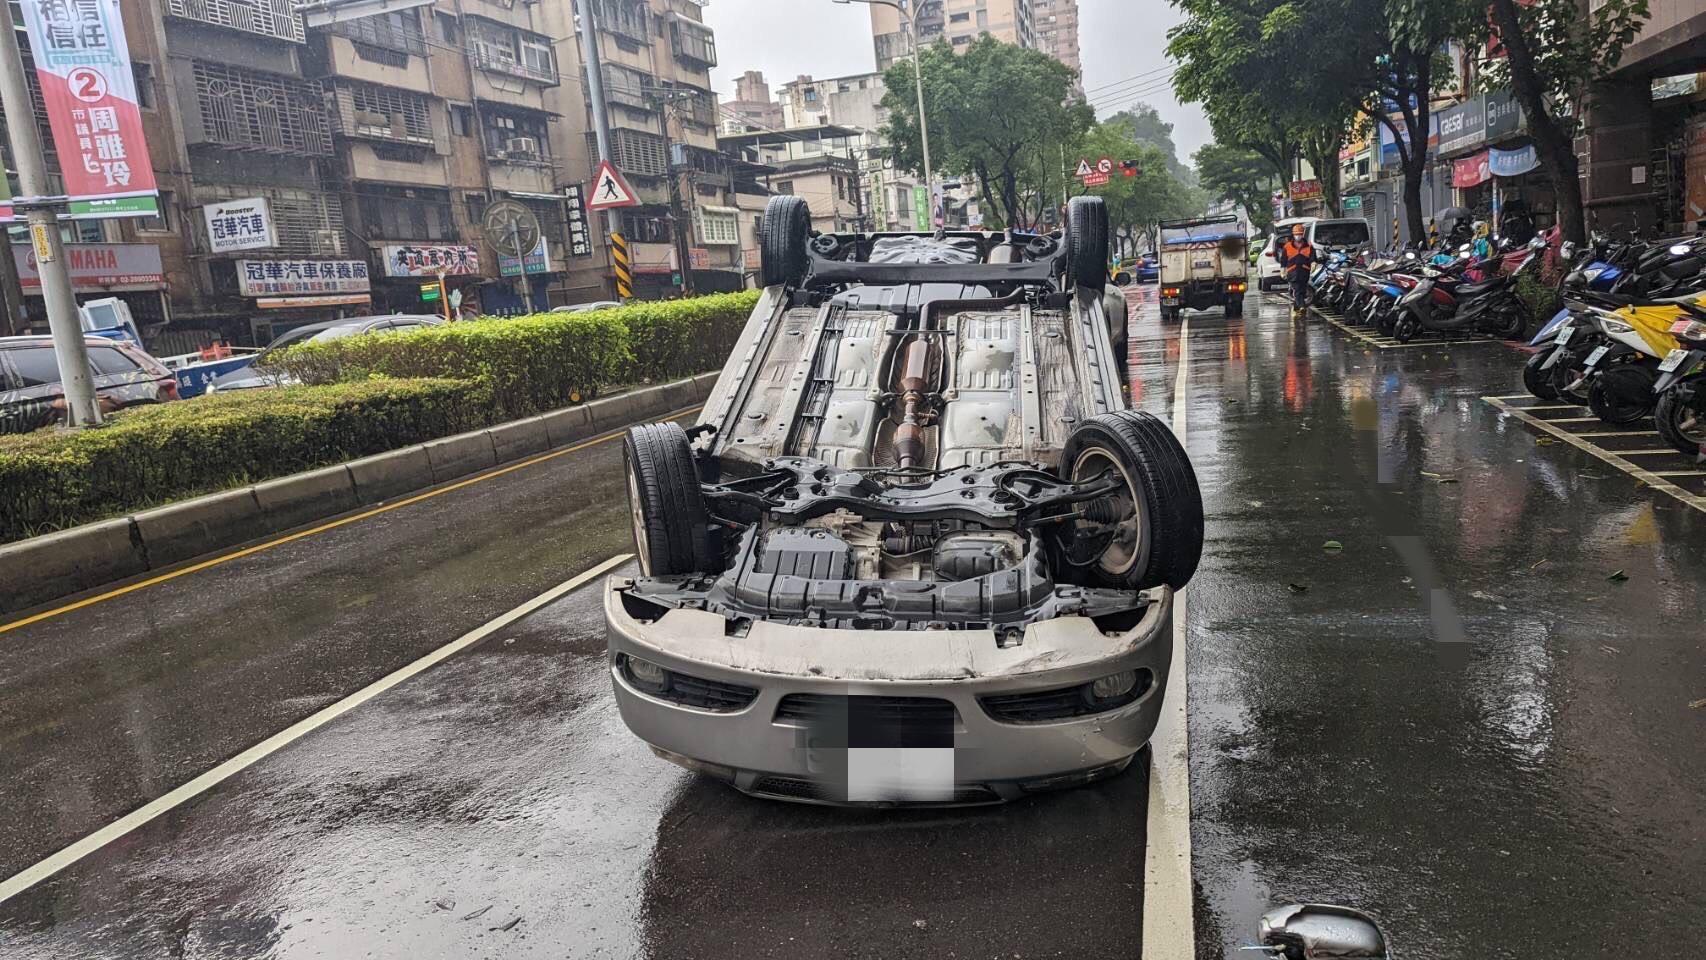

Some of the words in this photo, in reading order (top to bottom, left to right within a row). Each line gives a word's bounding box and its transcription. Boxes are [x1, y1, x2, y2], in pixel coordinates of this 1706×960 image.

[75, 72, 101, 97] 2
[88, 106, 131, 187] 周雅玲
[211, 213, 265, 239] 冠華汽車
[70, 249, 118, 270] MAHA
[246, 262, 369, 280] 冠華汽車保養廠
